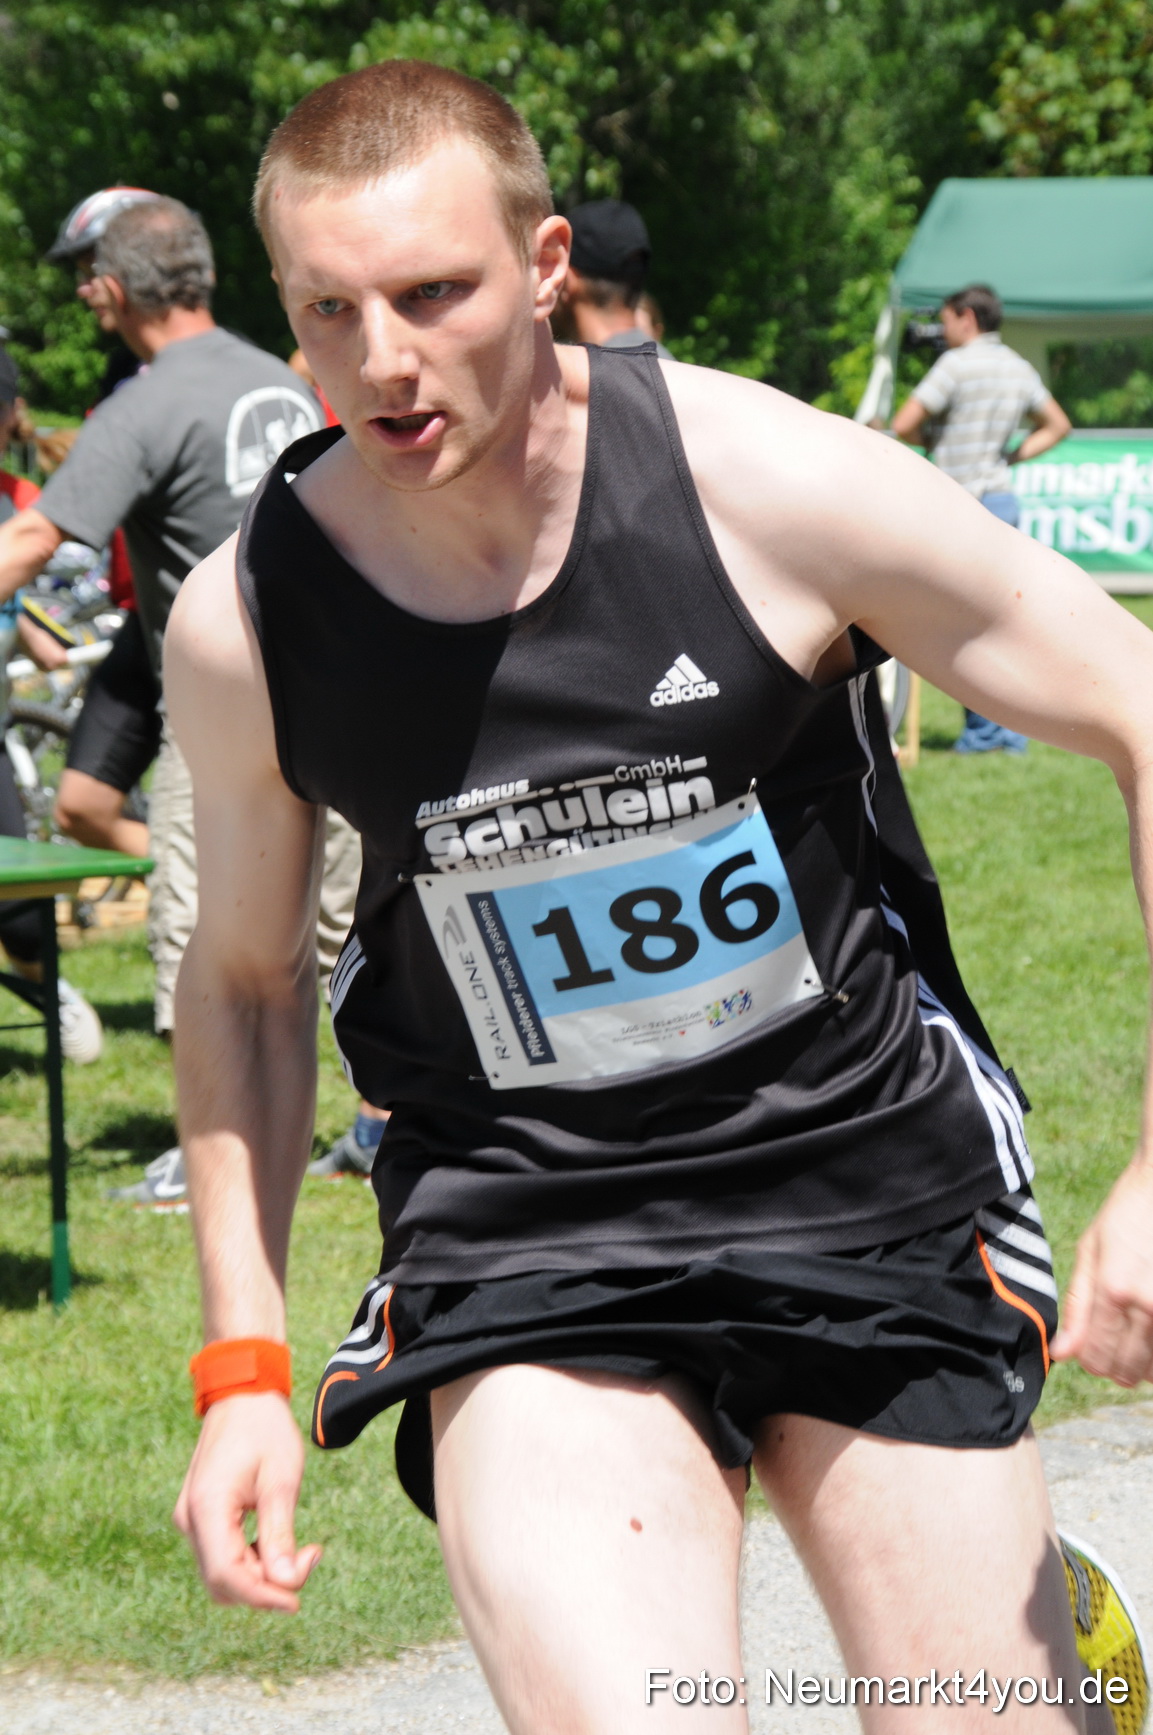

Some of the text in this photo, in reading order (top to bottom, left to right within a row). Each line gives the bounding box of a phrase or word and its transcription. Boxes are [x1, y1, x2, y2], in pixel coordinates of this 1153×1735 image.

[1019, 493, 1153, 553] msb
[650, 681, 720, 708] adidas
[415, 755, 683, 819] Autohaus GmbH
[424, 776, 716, 867] Schülein
[478, 900, 507, 954] systems
[532, 849, 780, 992] 186
[497, 956, 519, 989] track
[459, 951, 512, 1060] RAIL.ONE
